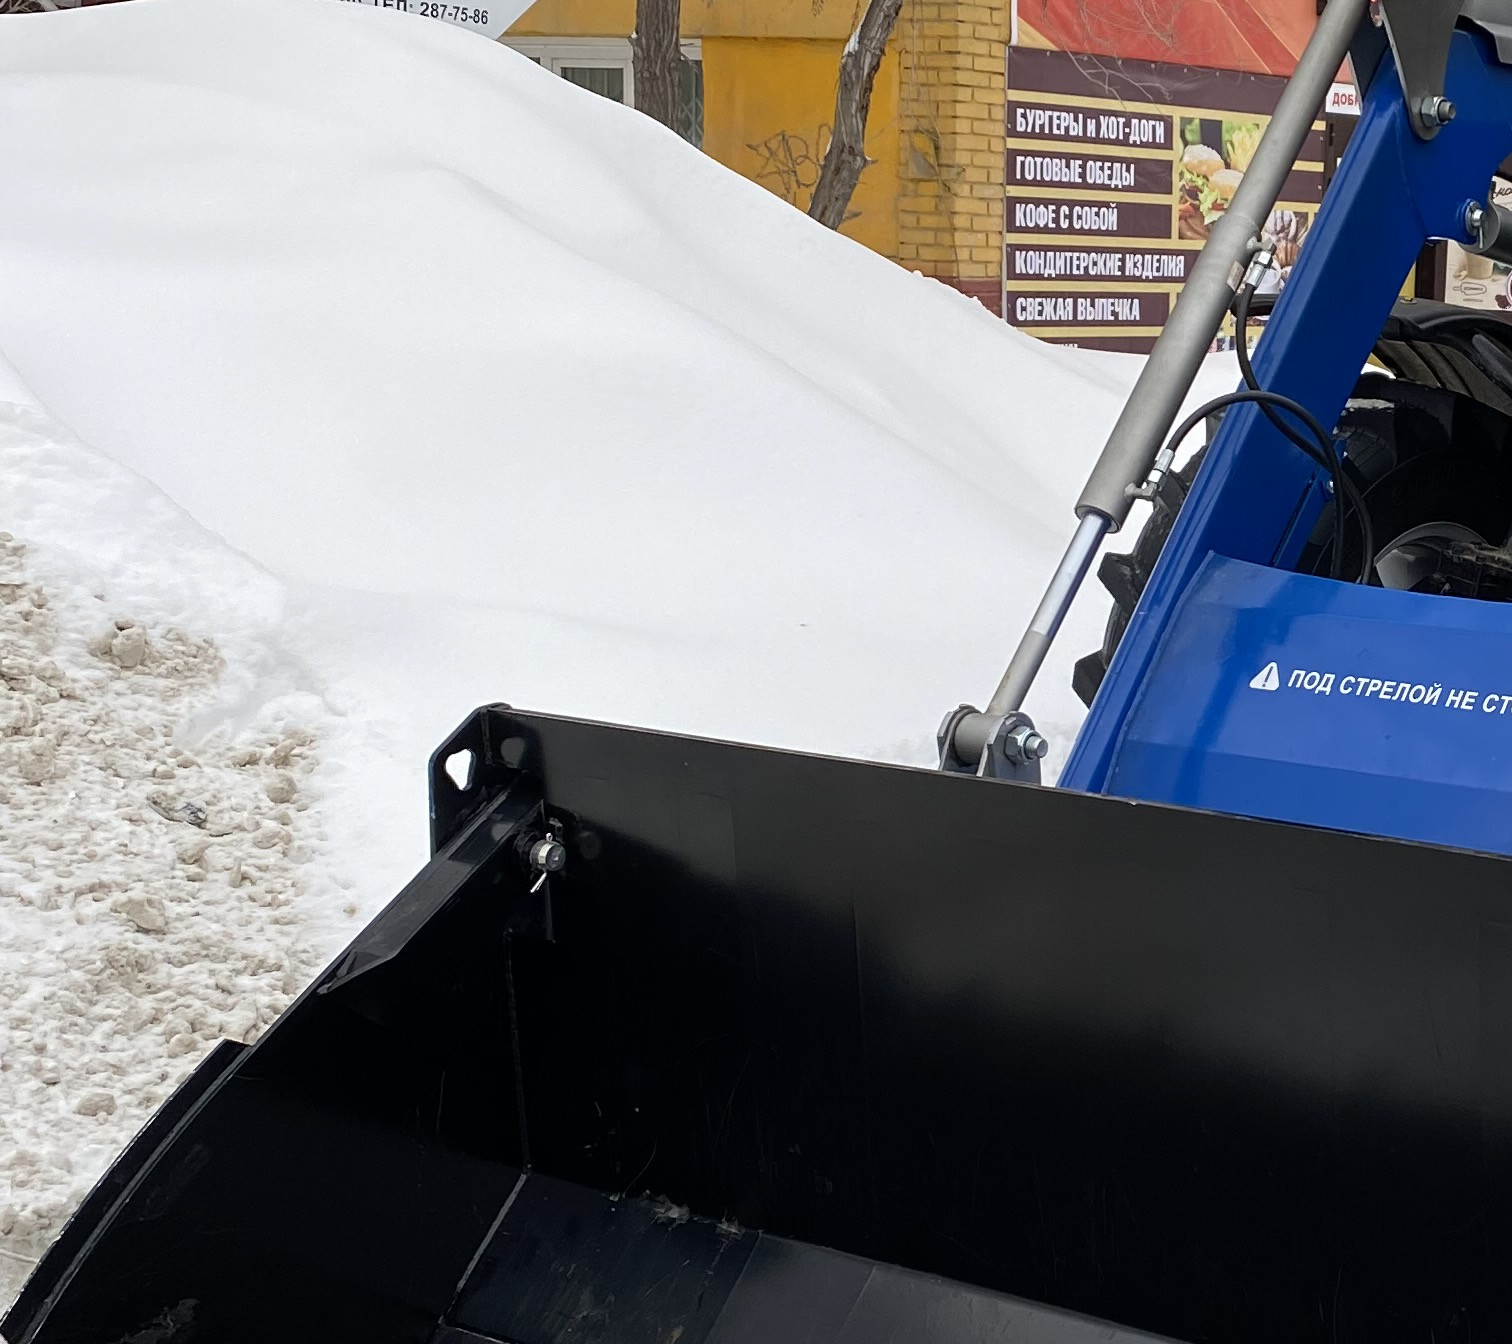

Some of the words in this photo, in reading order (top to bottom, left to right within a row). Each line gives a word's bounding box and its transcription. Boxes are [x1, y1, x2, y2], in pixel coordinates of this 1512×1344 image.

[420, 1, 489, 25] 287-75-86
[1016, 108, 1083, 137] БУРГЕРЫ
[1087, 118, 1096, 138] и
[1099, 115, 1165, 145] ХОТ-ДОГИ
[1016, 156, 1083, 183] ГОТОВЫЕ
[1086, 159, 1135, 189] ОБЕДЫ
[1015, 203, 1056, 228] КОФЕ
[1060, 205, 1069, 229] С
[1073, 203, 1118, 231] СОБОЙ
[1015, 250, 1121, 278] КОНДИТЕРСКИЕ
[1125, 253, 1185, 280] ИЗДЕЛИЯ
[1016, 297, 1073, 321] СВЕЖАЯ
[1077, 298, 1141, 321] ВЫПЕЧКА
[1288, 669, 1333, 697] ПОД
[1339, 675, 1442, 706] СТРЕЛОЙ
[1445, 689, 1479, 711] НЕ
